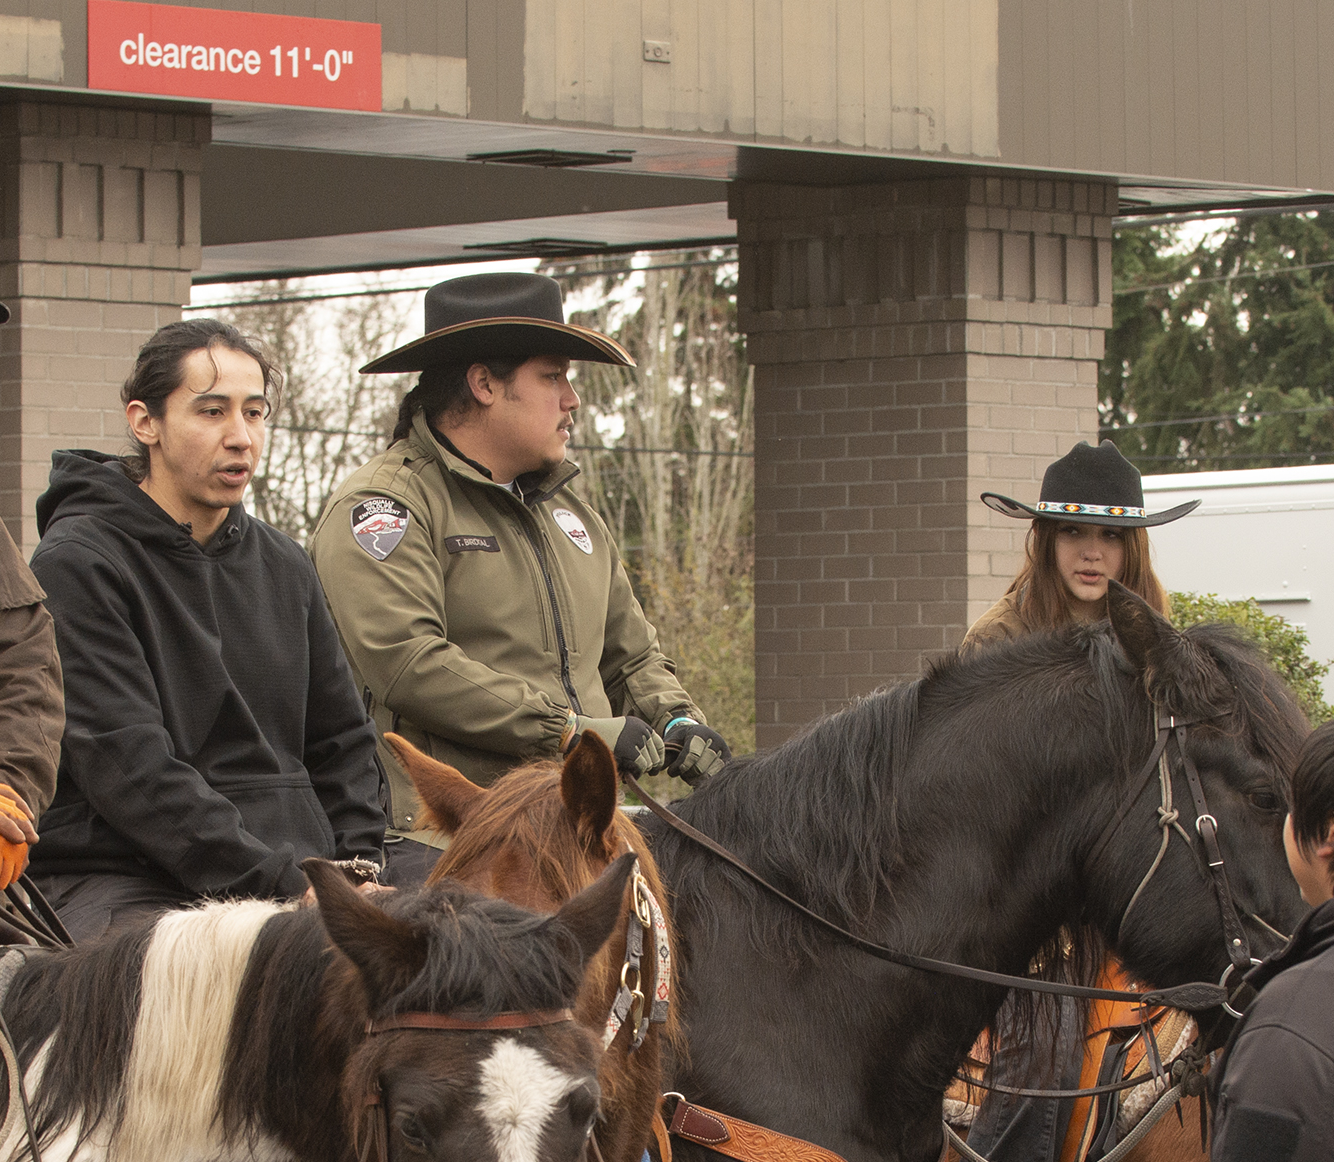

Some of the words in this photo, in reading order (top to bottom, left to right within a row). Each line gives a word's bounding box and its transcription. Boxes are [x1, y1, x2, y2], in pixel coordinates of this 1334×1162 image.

[119, 32, 262, 76] clearance
[269, 45, 354, 82] 11'-0"
[357, 508, 402, 521] ENFORCEMENT
